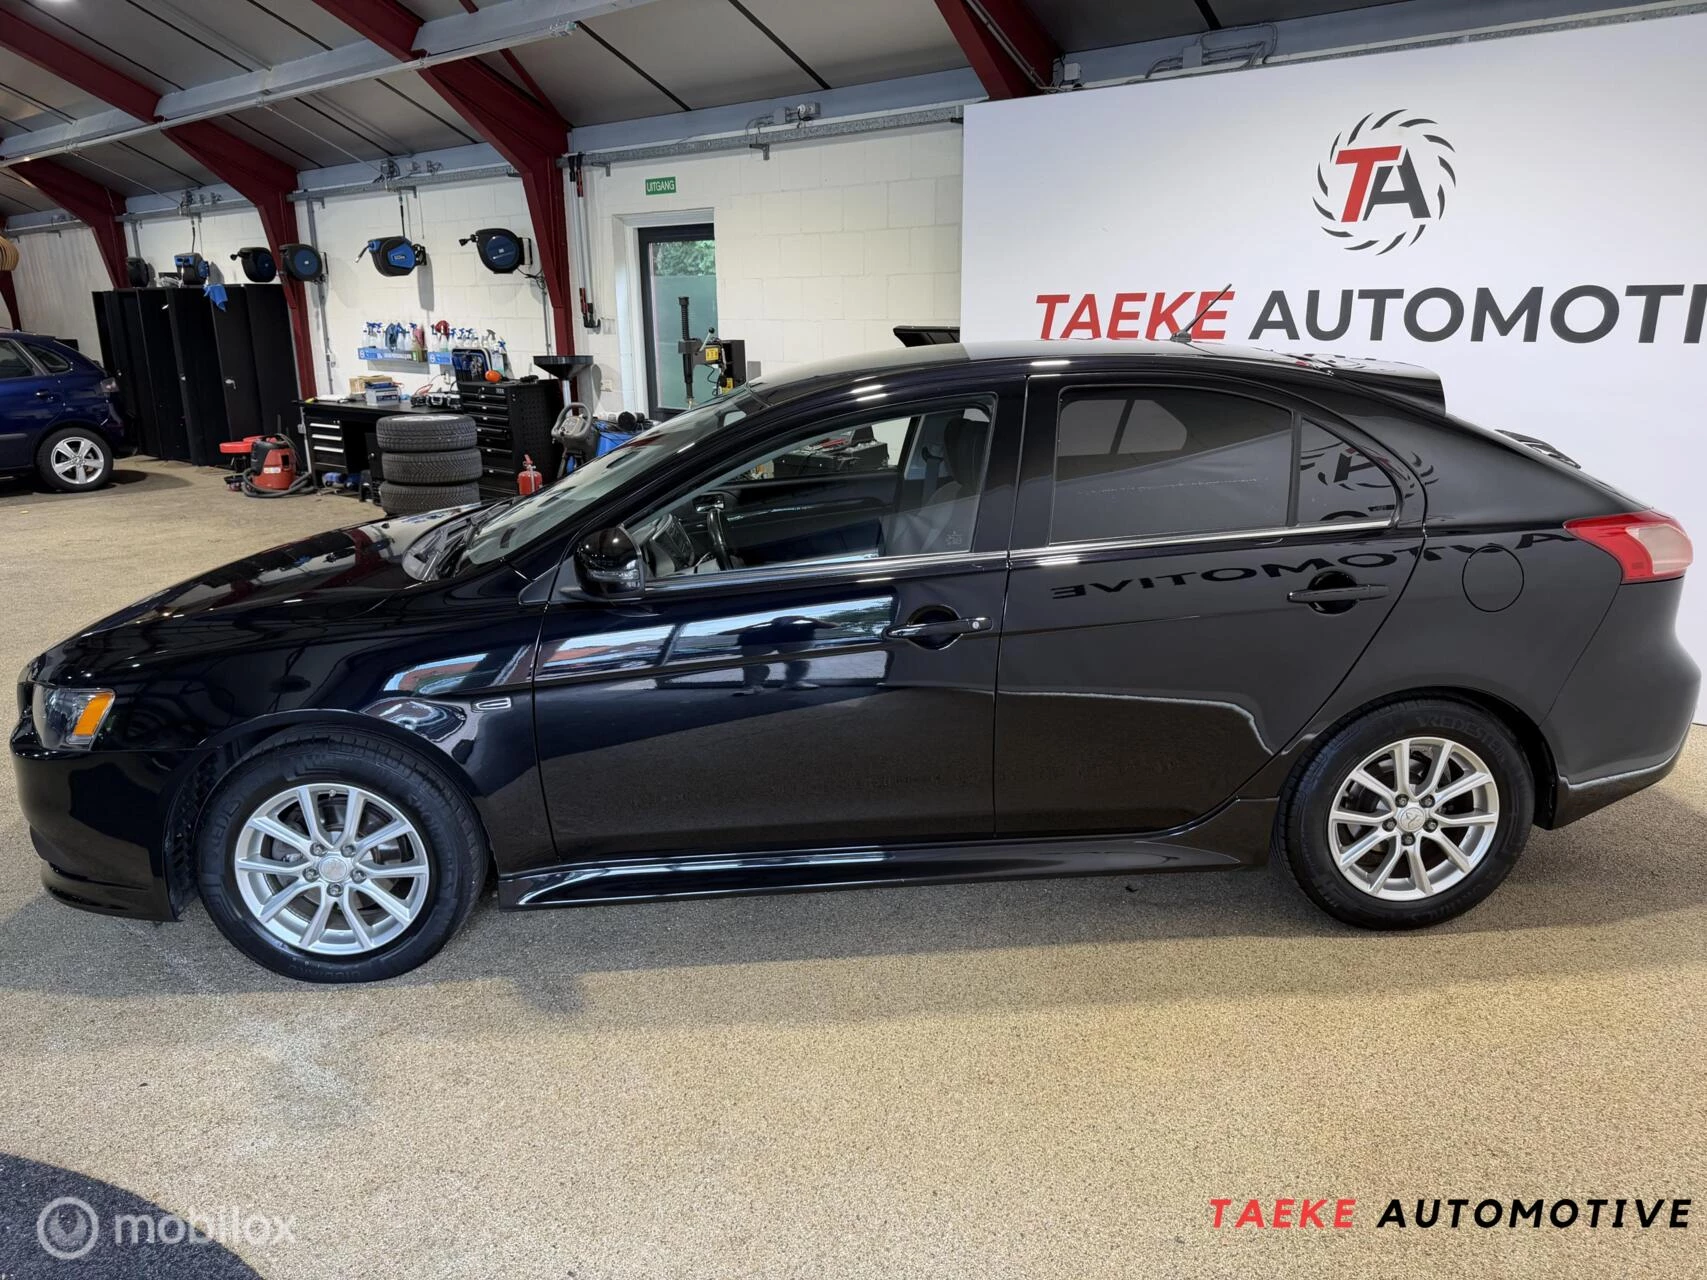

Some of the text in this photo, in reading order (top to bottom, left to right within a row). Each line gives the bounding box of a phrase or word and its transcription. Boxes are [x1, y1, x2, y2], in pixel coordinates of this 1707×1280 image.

[647, 180, 675, 192] UITGANG
[1335, 145, 1431, 223] TA
[1036, 284, 1707, 344] TAEKE AUTOMOTI
